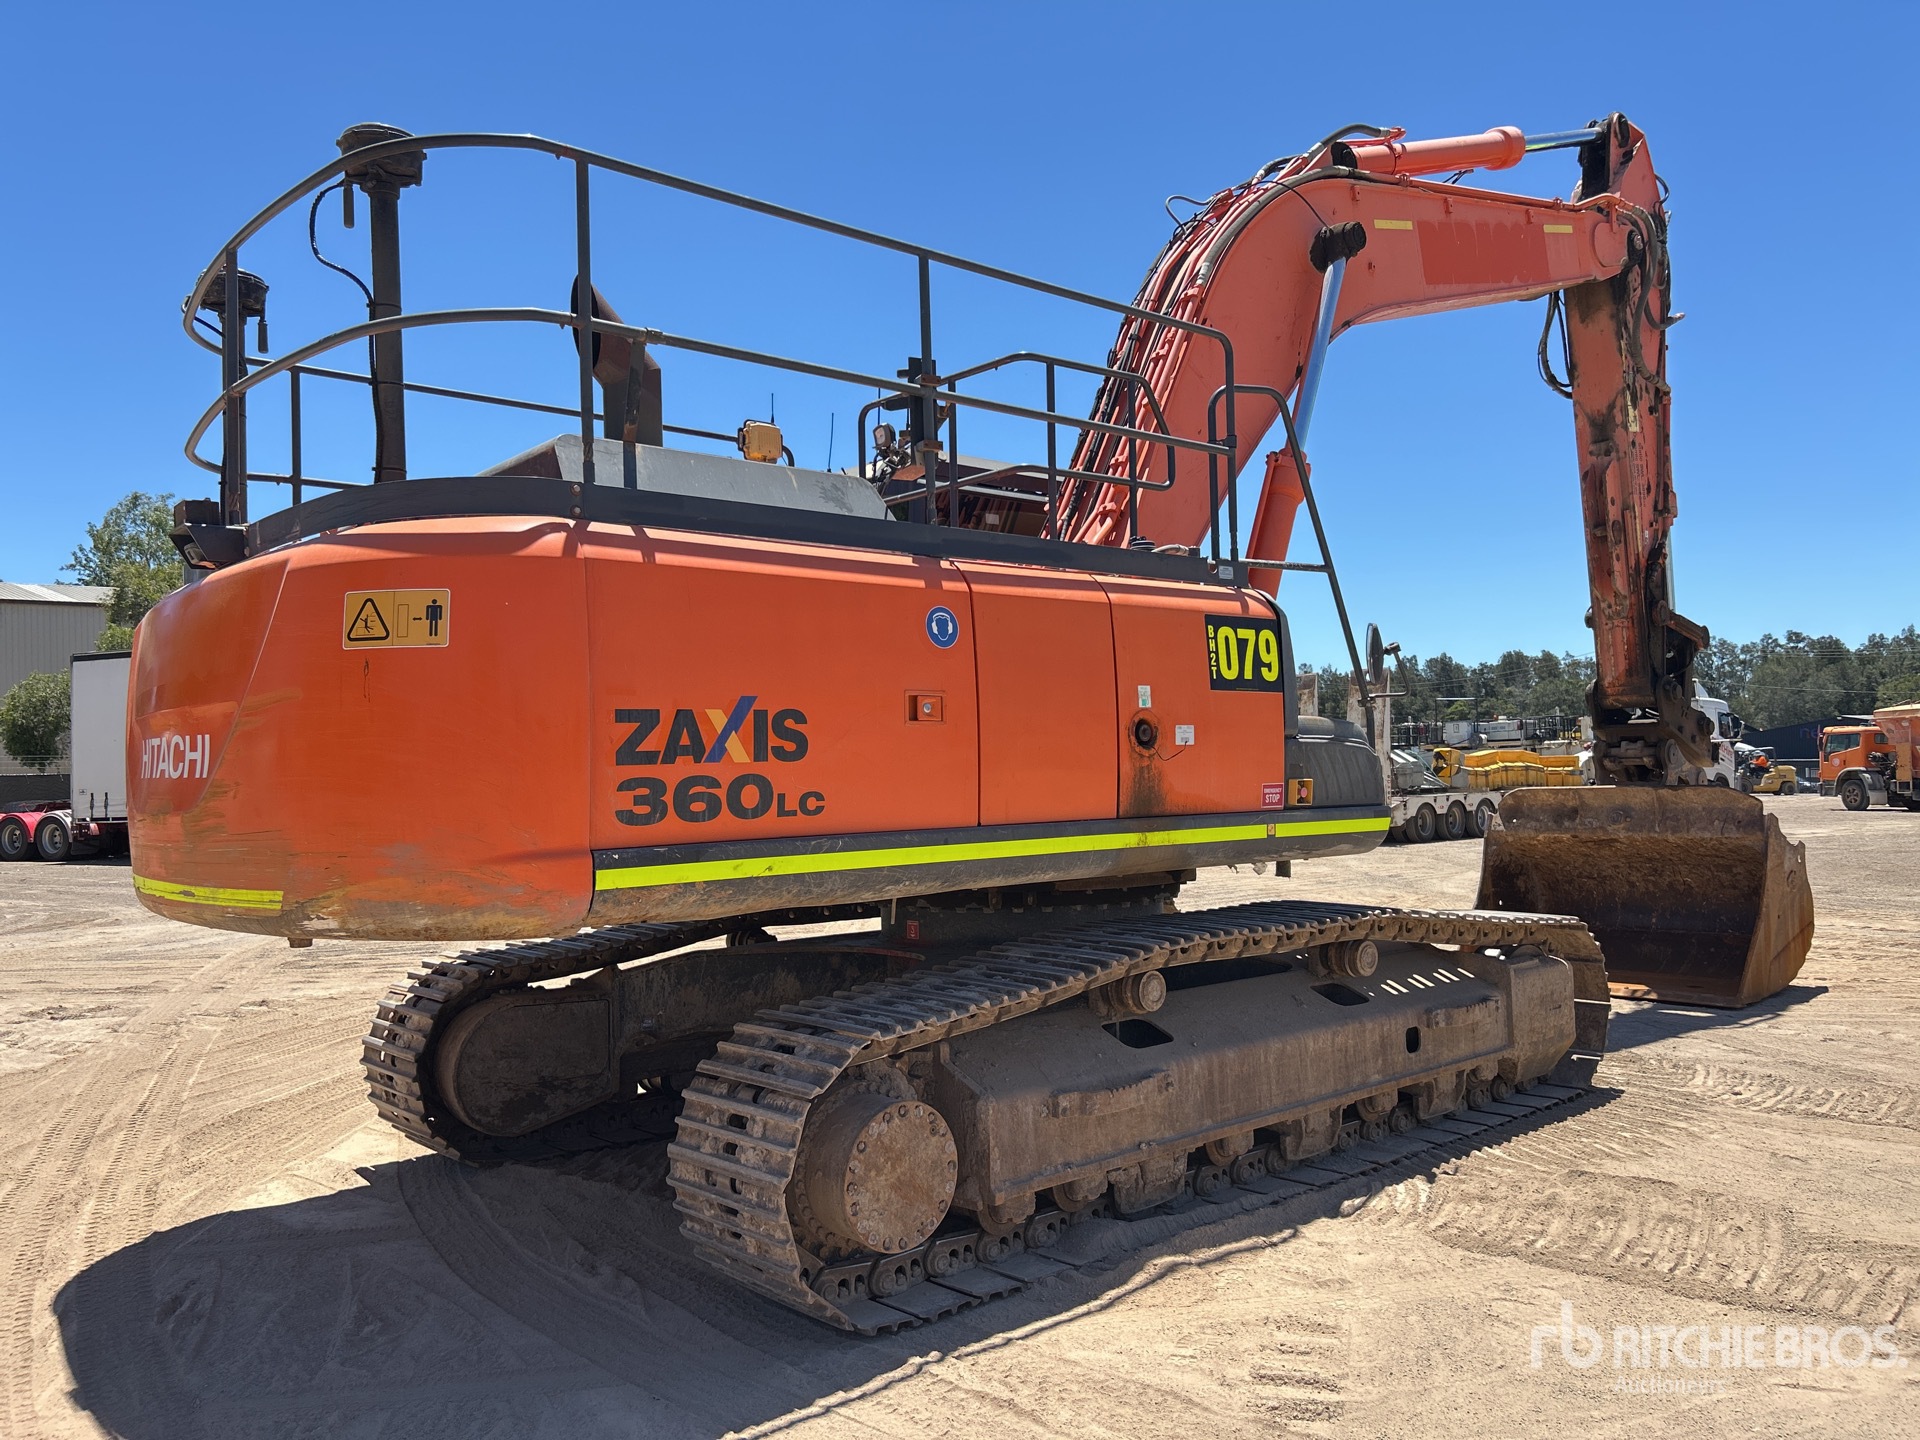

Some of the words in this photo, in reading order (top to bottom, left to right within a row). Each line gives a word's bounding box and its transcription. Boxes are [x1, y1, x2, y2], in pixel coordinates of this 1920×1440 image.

[1207, 624, 1217, 680] BH2T
[1217, 626, 1279, 682] 079
[141, 734, 211, 779] HITACHI
[615, 696, 809, 766] ZAXIS
[1265, 793, 1281, 803] STOP
